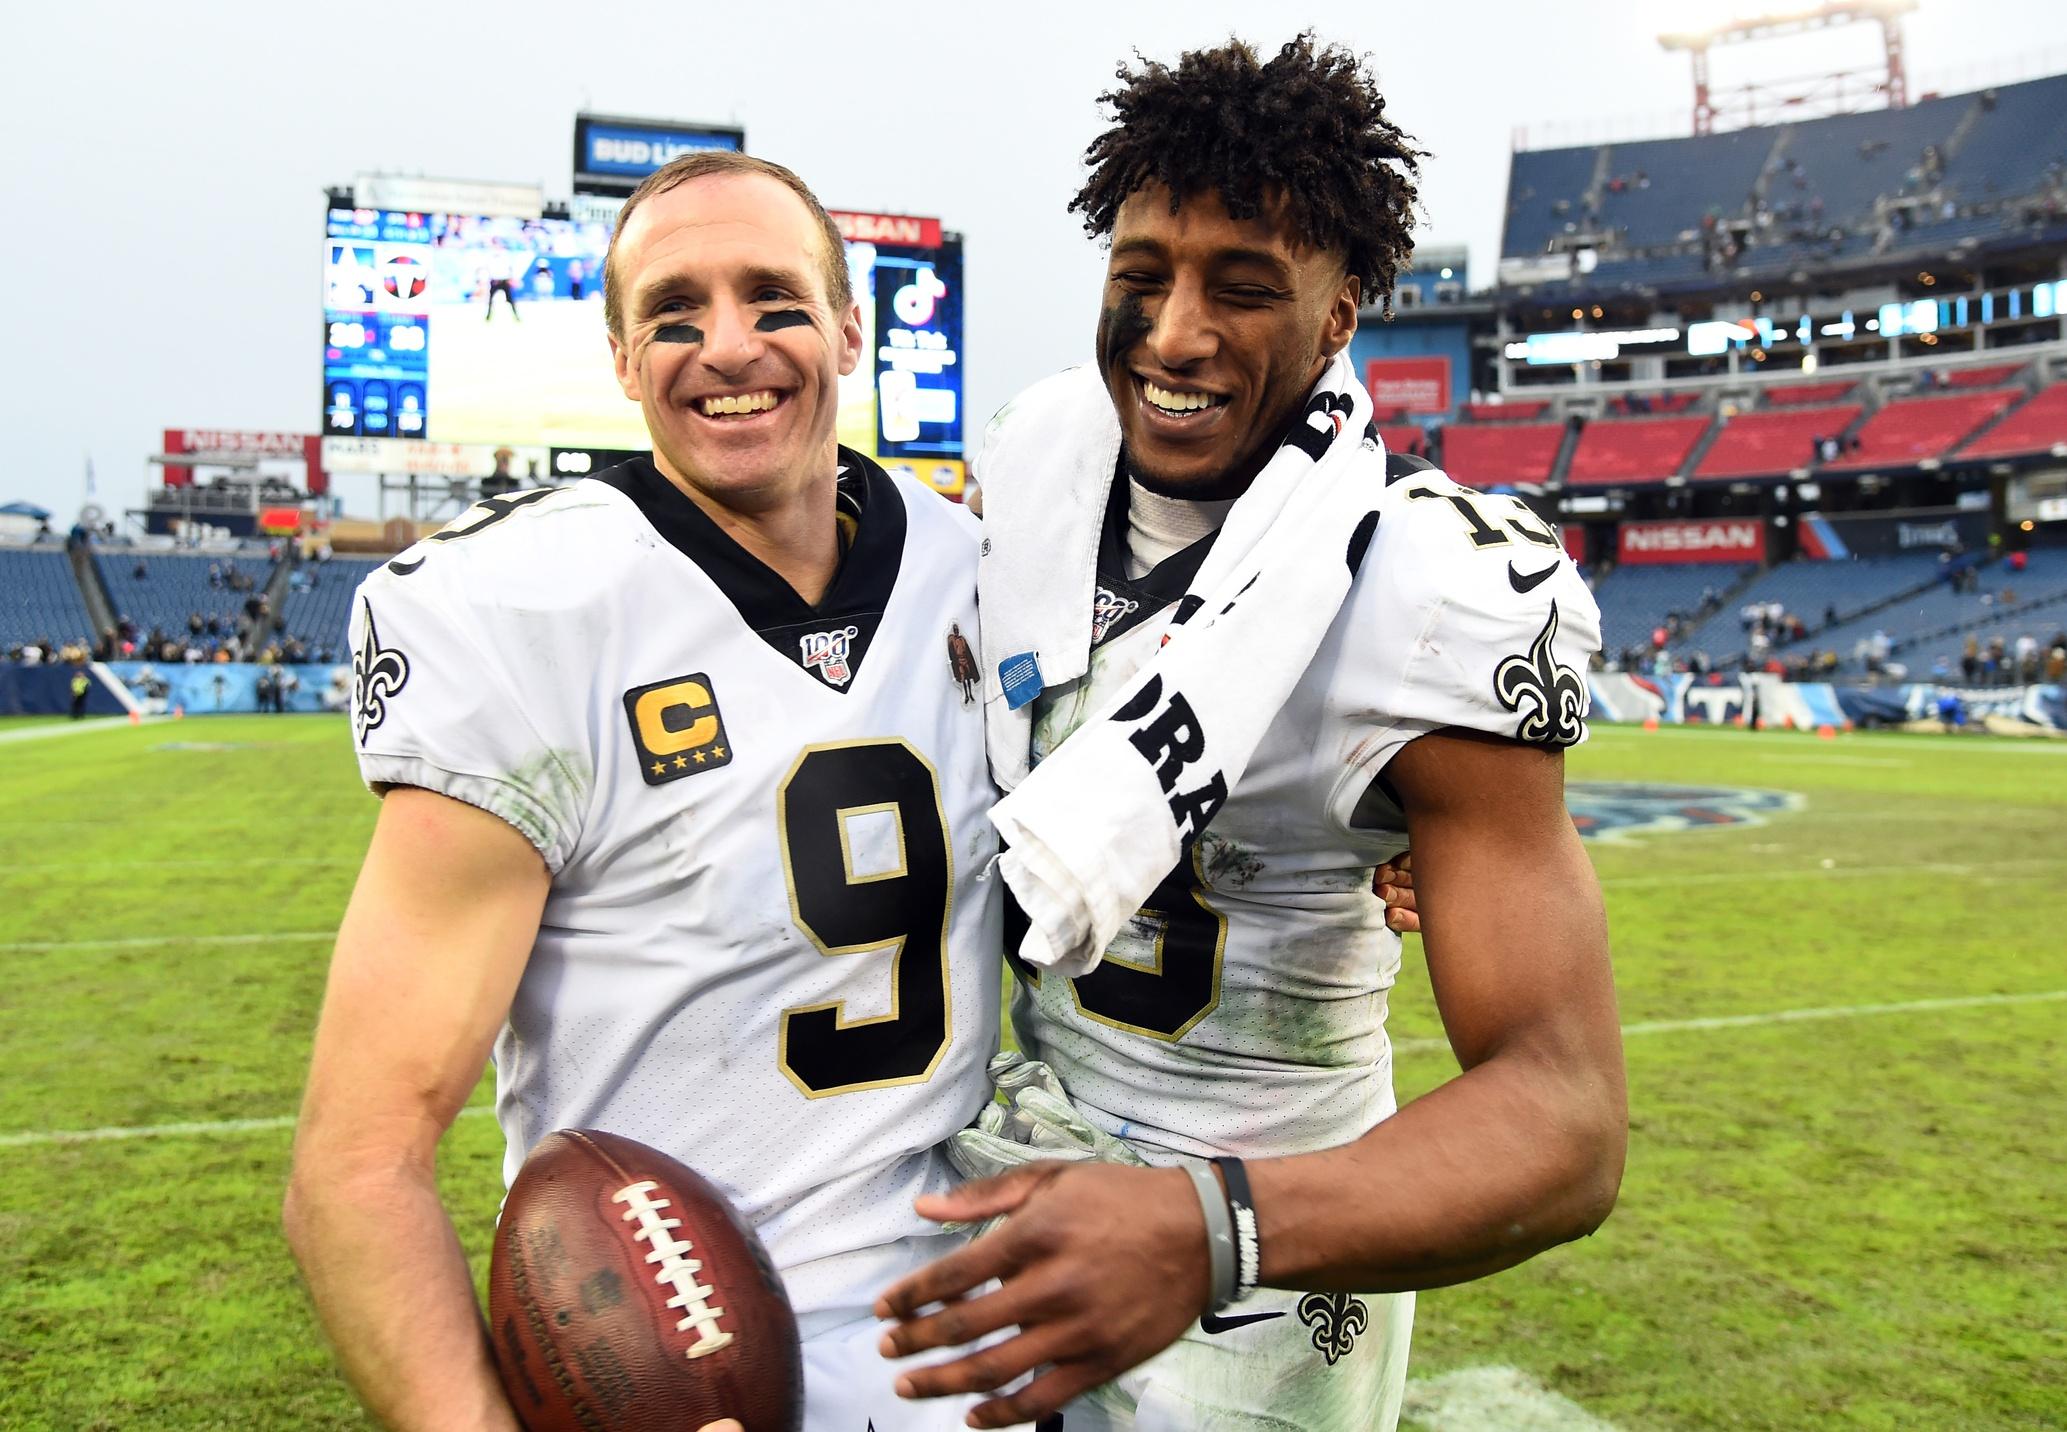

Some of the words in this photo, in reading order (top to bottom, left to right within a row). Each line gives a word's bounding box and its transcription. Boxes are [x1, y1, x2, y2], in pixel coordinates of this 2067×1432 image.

[592, 137, 650, 165] BUD
[832, 215, 921, 243] SSAN
[182, 429, 305, 453] NISSAN
[1624, 524, 1756, 552] NISSAN
[635, 681, 718, 757] C
[777, 736, 953, 1100] 9
